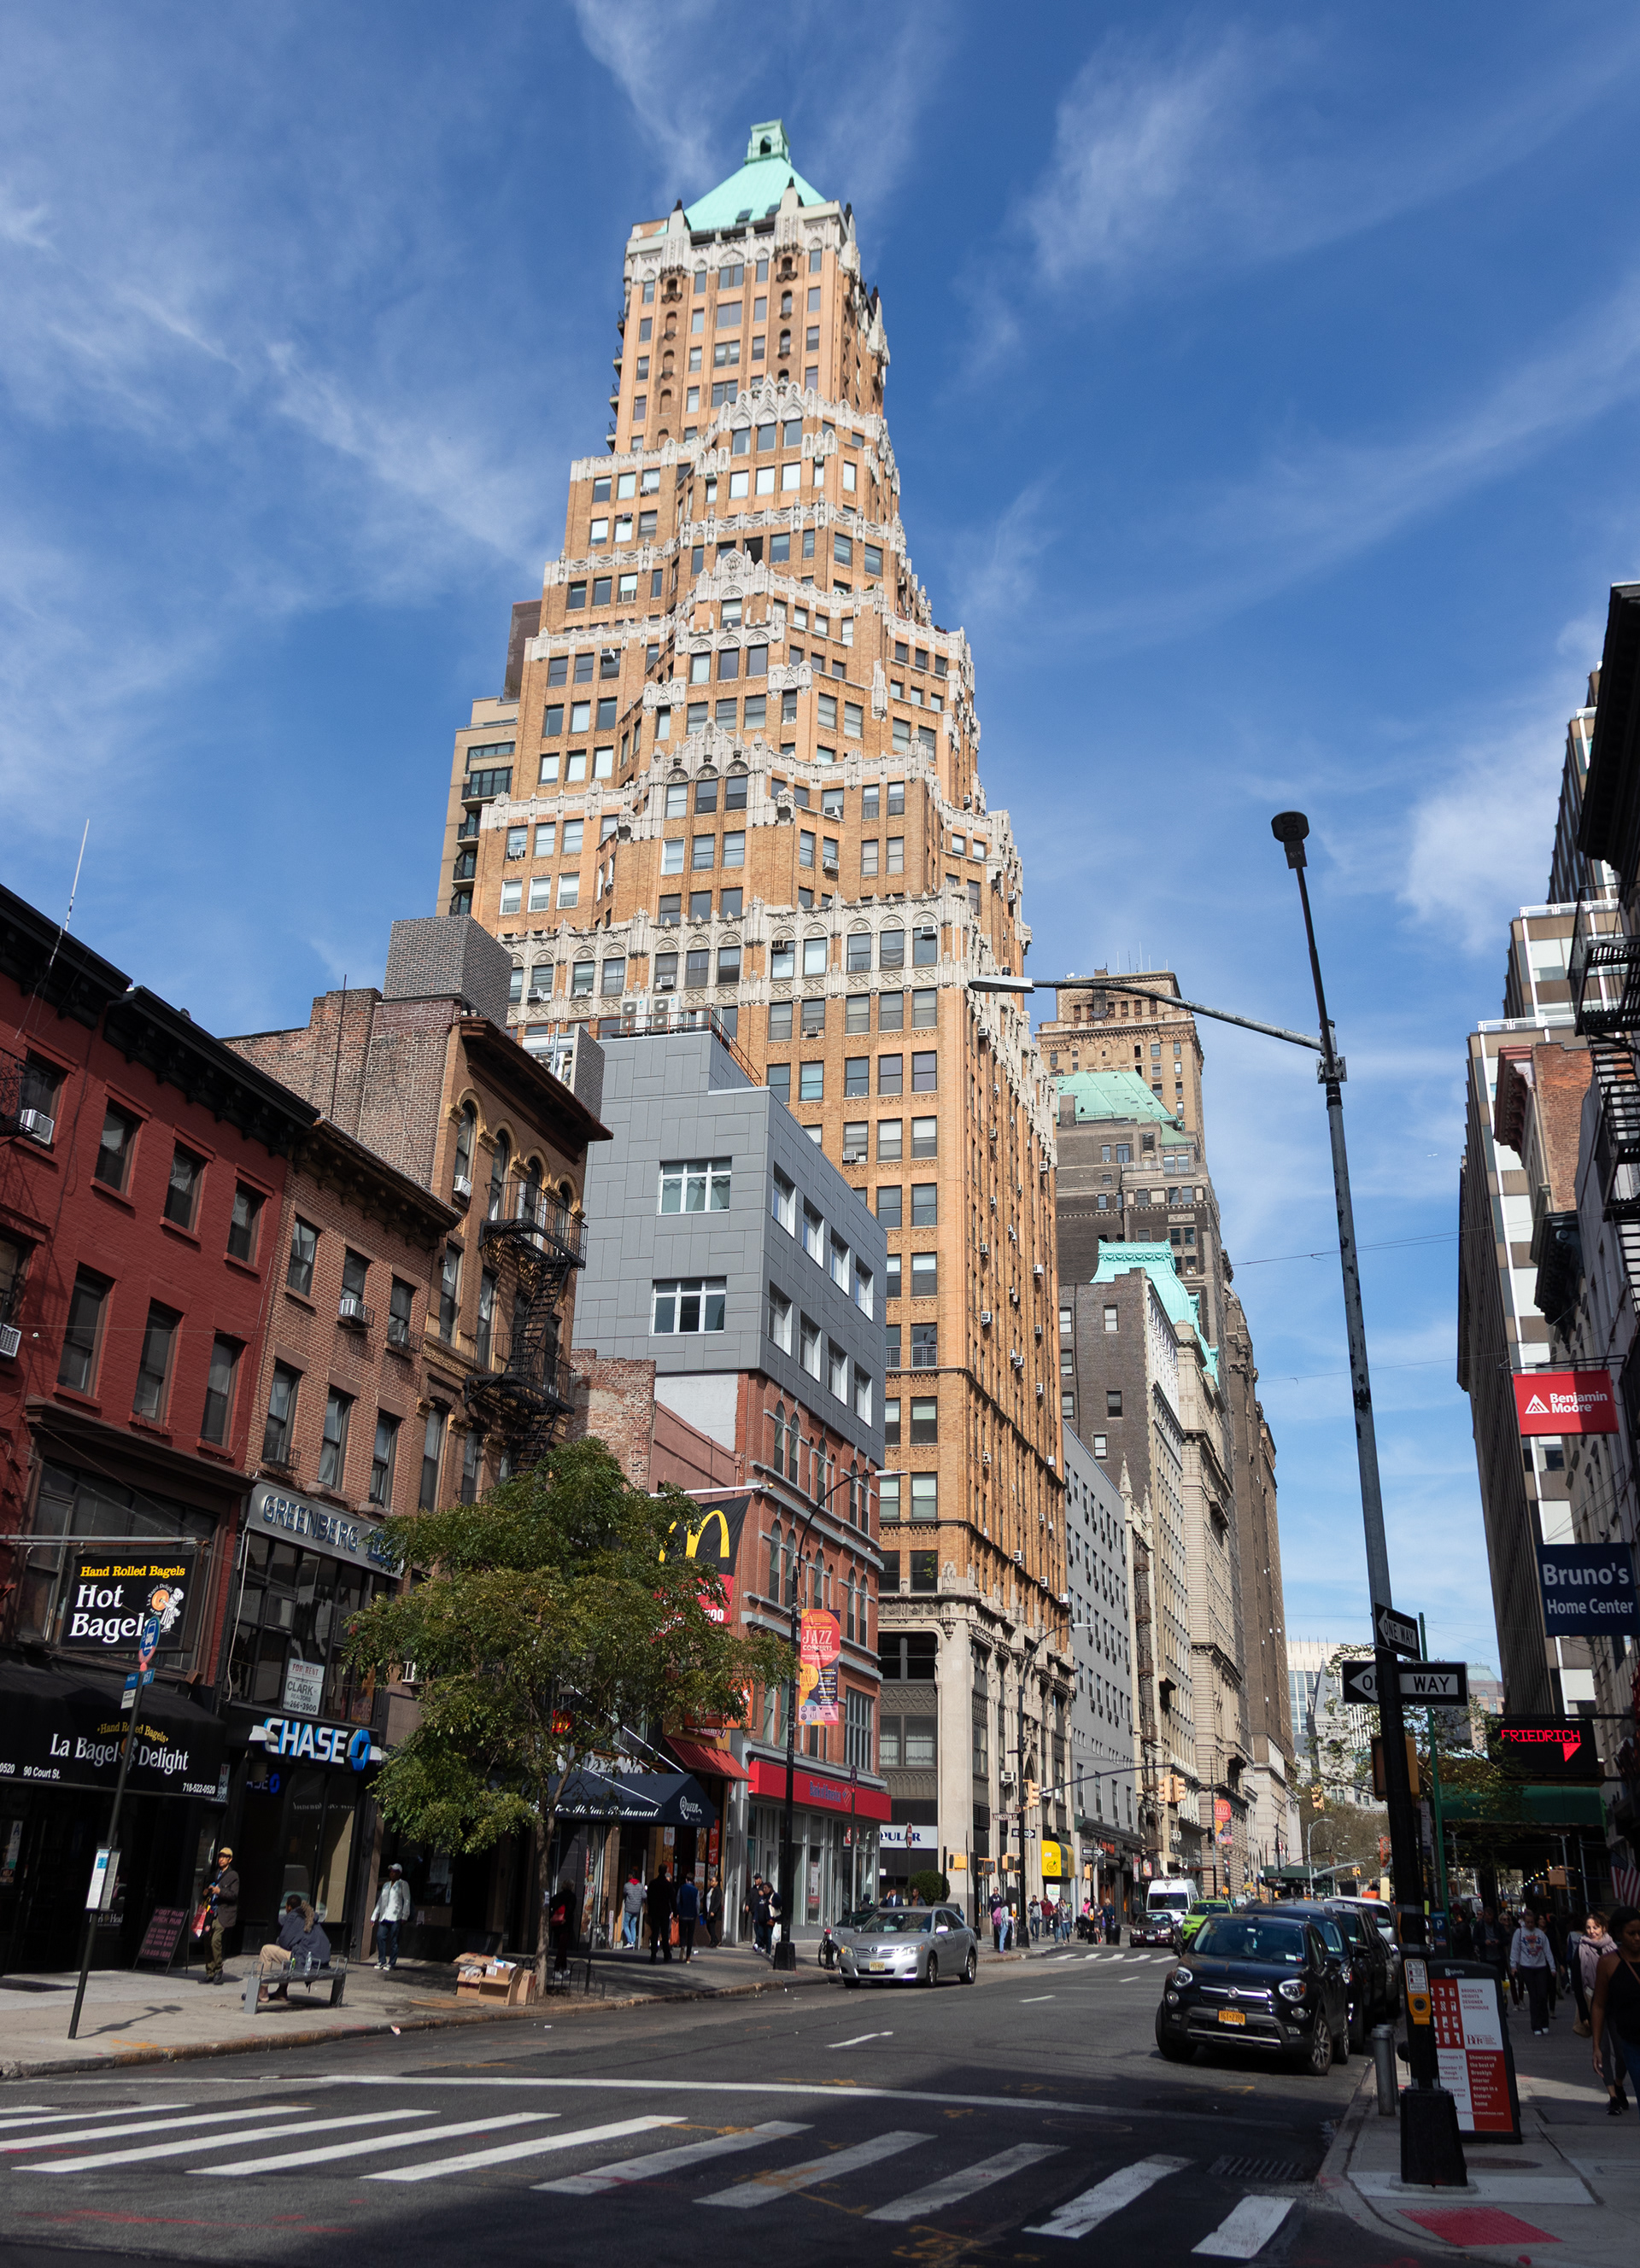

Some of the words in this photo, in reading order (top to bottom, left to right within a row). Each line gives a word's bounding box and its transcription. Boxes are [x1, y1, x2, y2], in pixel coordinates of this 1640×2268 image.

[1549, 1390, 1608, 1405] Benjamin
[1551, 1403, 1592, 1413] Moore
[261, 1494, 359, 1552] GREENBERG
[79, 1566, 110, 1577] Hand
[112, 1565, 147, 1577] Rolled
[149, 1565, 185, 1579] Bagels
[1542, 1562, 1630, 1586] Bruno's
[75, 1584, 125, 1608] Hot
[1546, 1599, 1587, 1615] Home
[1589, 1598, 1633, 1614] Center
[802, 1629, 833, 1645] JAZZ
[1384, 1619, 1398, 1640] ONE
[1400, 1626, 1414, 1645] WAY
[292, 1663, 303, 1674] FOR
[304, 1666, 319, 1676] RENT
[287, 1681, 313, 1696] CLARK
[1414, 1675, 1450, 1692] WAY
[290, 1693, 311, 1703] REALTORS
[290, 1700, 317, 1712] 266-3900
[100, 1722, 120, 1734] Hand
[121, 1721, 144, 1735] Roed
[144, 1725, 167, 1743] Bagels
[1501, 1729, 1581, 1742] FRIEDRICH
[264, 1717, 348, 1764] CHASE
[50, 1733, 69, 1757] La
[74, 1737, 120, 1768] Bagel
[138, 1745, 189, 1775] Delight
[23, 1765, 32, 1776] 90
[32, 1767, 52, 1779] Court
[52, 1769, 61, 1780] St.
[182, 1782, 216, 1795] 718-522-0520
[810, 1780, 820, 1797] Bank
[825, 1784, 841, 1803] America
[13, 1823, 20, 1836] A
[880, 1831, 921, 1842] PULR
[153, 1915, 169, 1924] BACK
[169, 1917, 182, 1926] RUB
[171, 1909, 184, 1918] RUB
